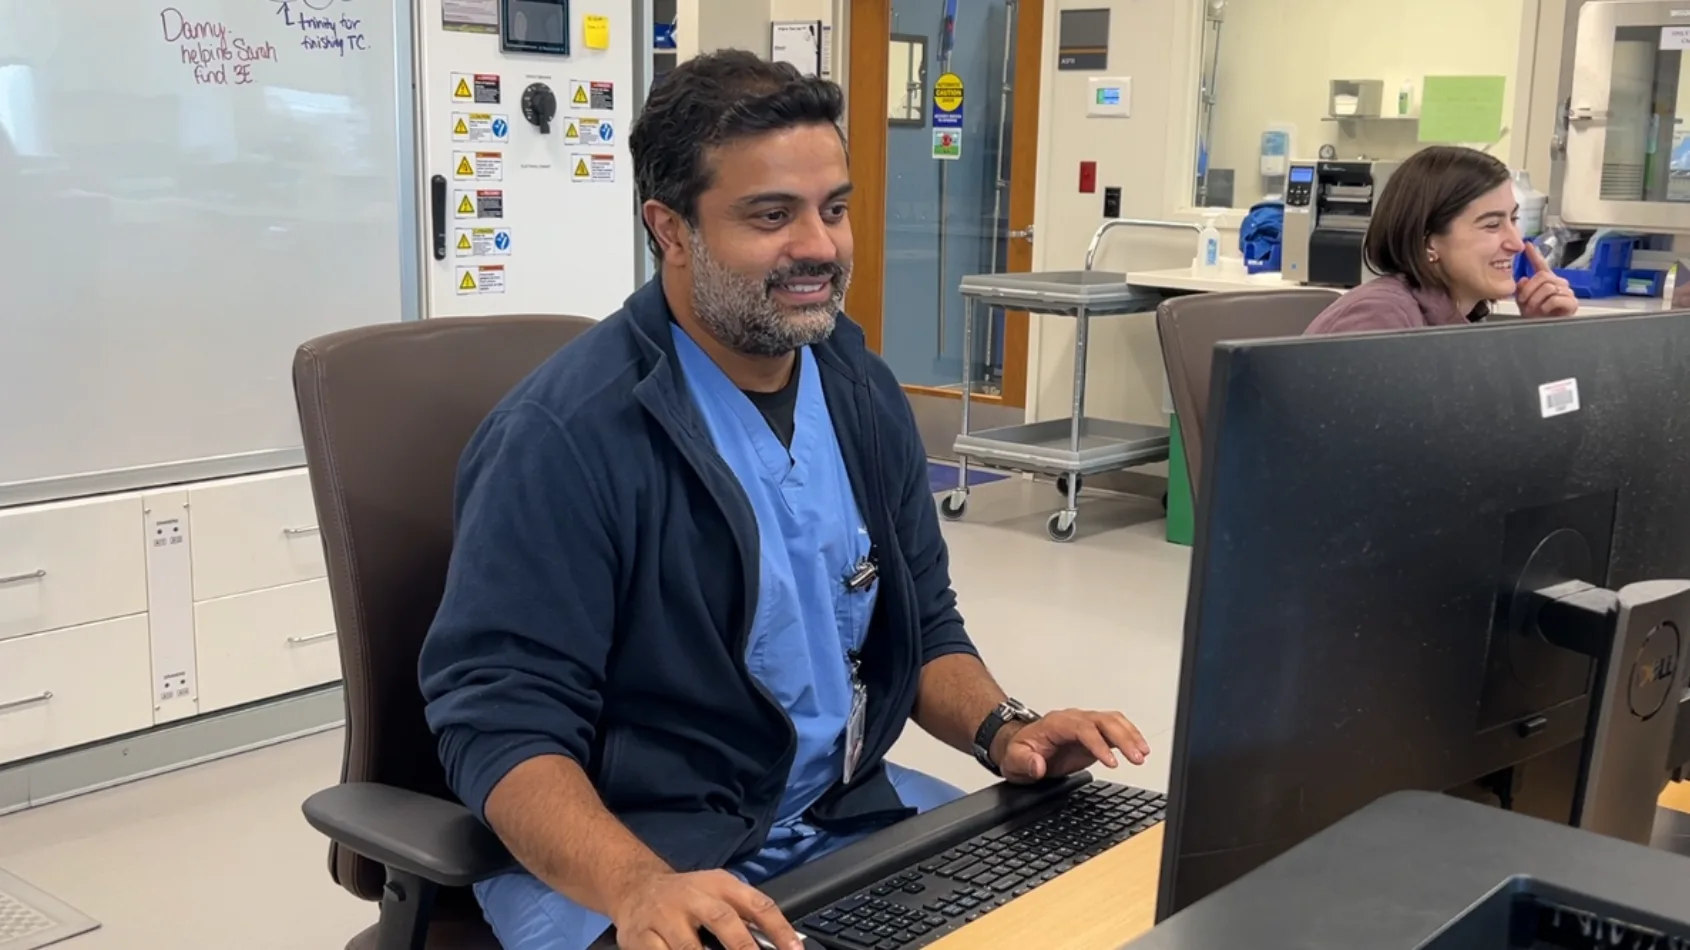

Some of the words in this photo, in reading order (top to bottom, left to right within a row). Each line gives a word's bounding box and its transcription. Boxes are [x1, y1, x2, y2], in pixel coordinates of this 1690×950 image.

[340, 13, 361, 30] for
[181, 42, 232, 67] helping
[233, 38, 278, 62] Sarah
[301, 35, 344, 57] finishing
[194, 64, 228, 84] find
[935, 89, 962, 97] CAUTION
